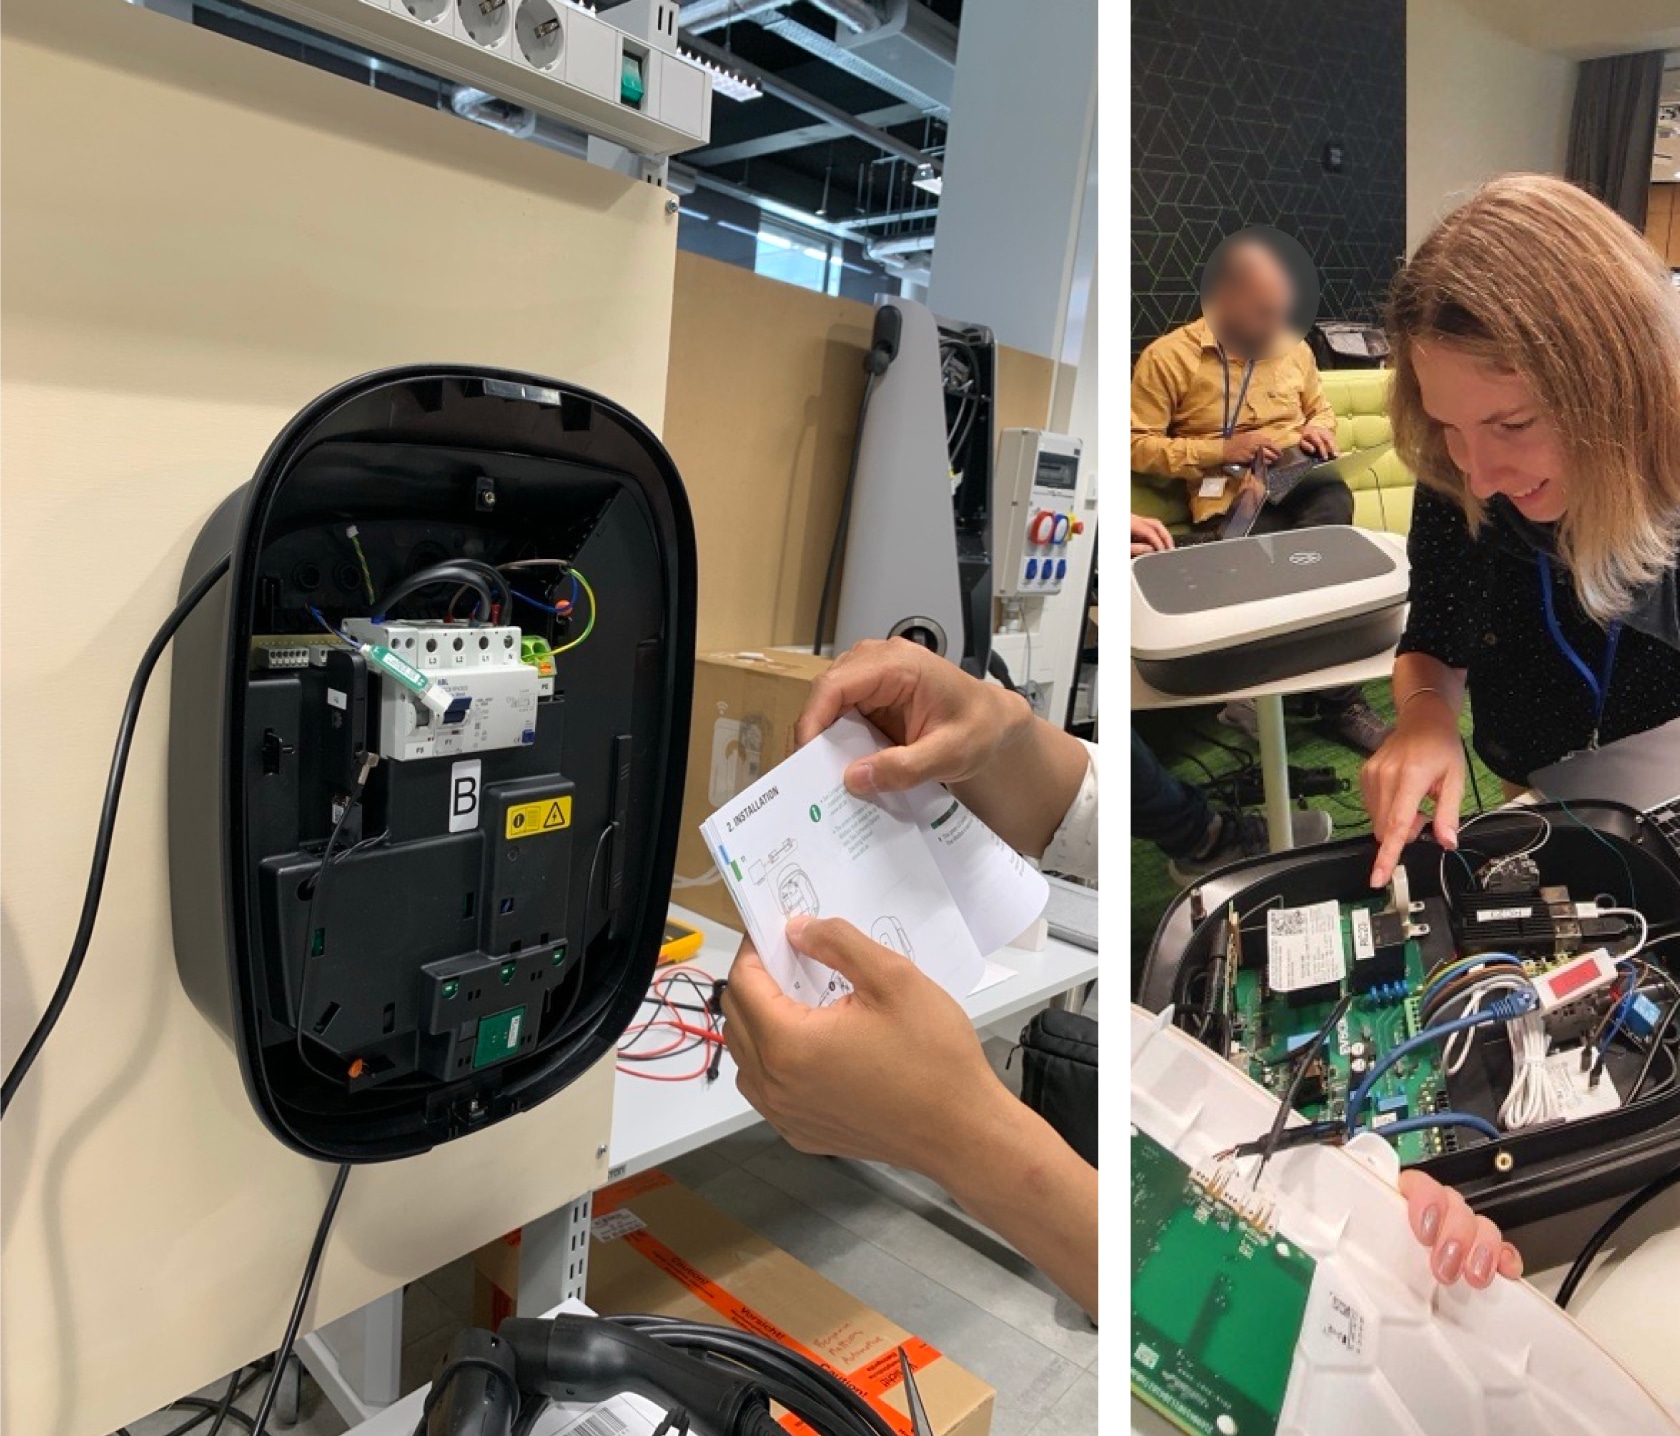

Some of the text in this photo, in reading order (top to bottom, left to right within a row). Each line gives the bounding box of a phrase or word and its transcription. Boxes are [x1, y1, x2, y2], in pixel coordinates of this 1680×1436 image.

[453, 776, 477, 816] B
[733, 785, 779, 827] INSTALLATION
[671, 1257, 709, 1285] Caution!
[741, 1307, 785, 1340] Vorsicht!
